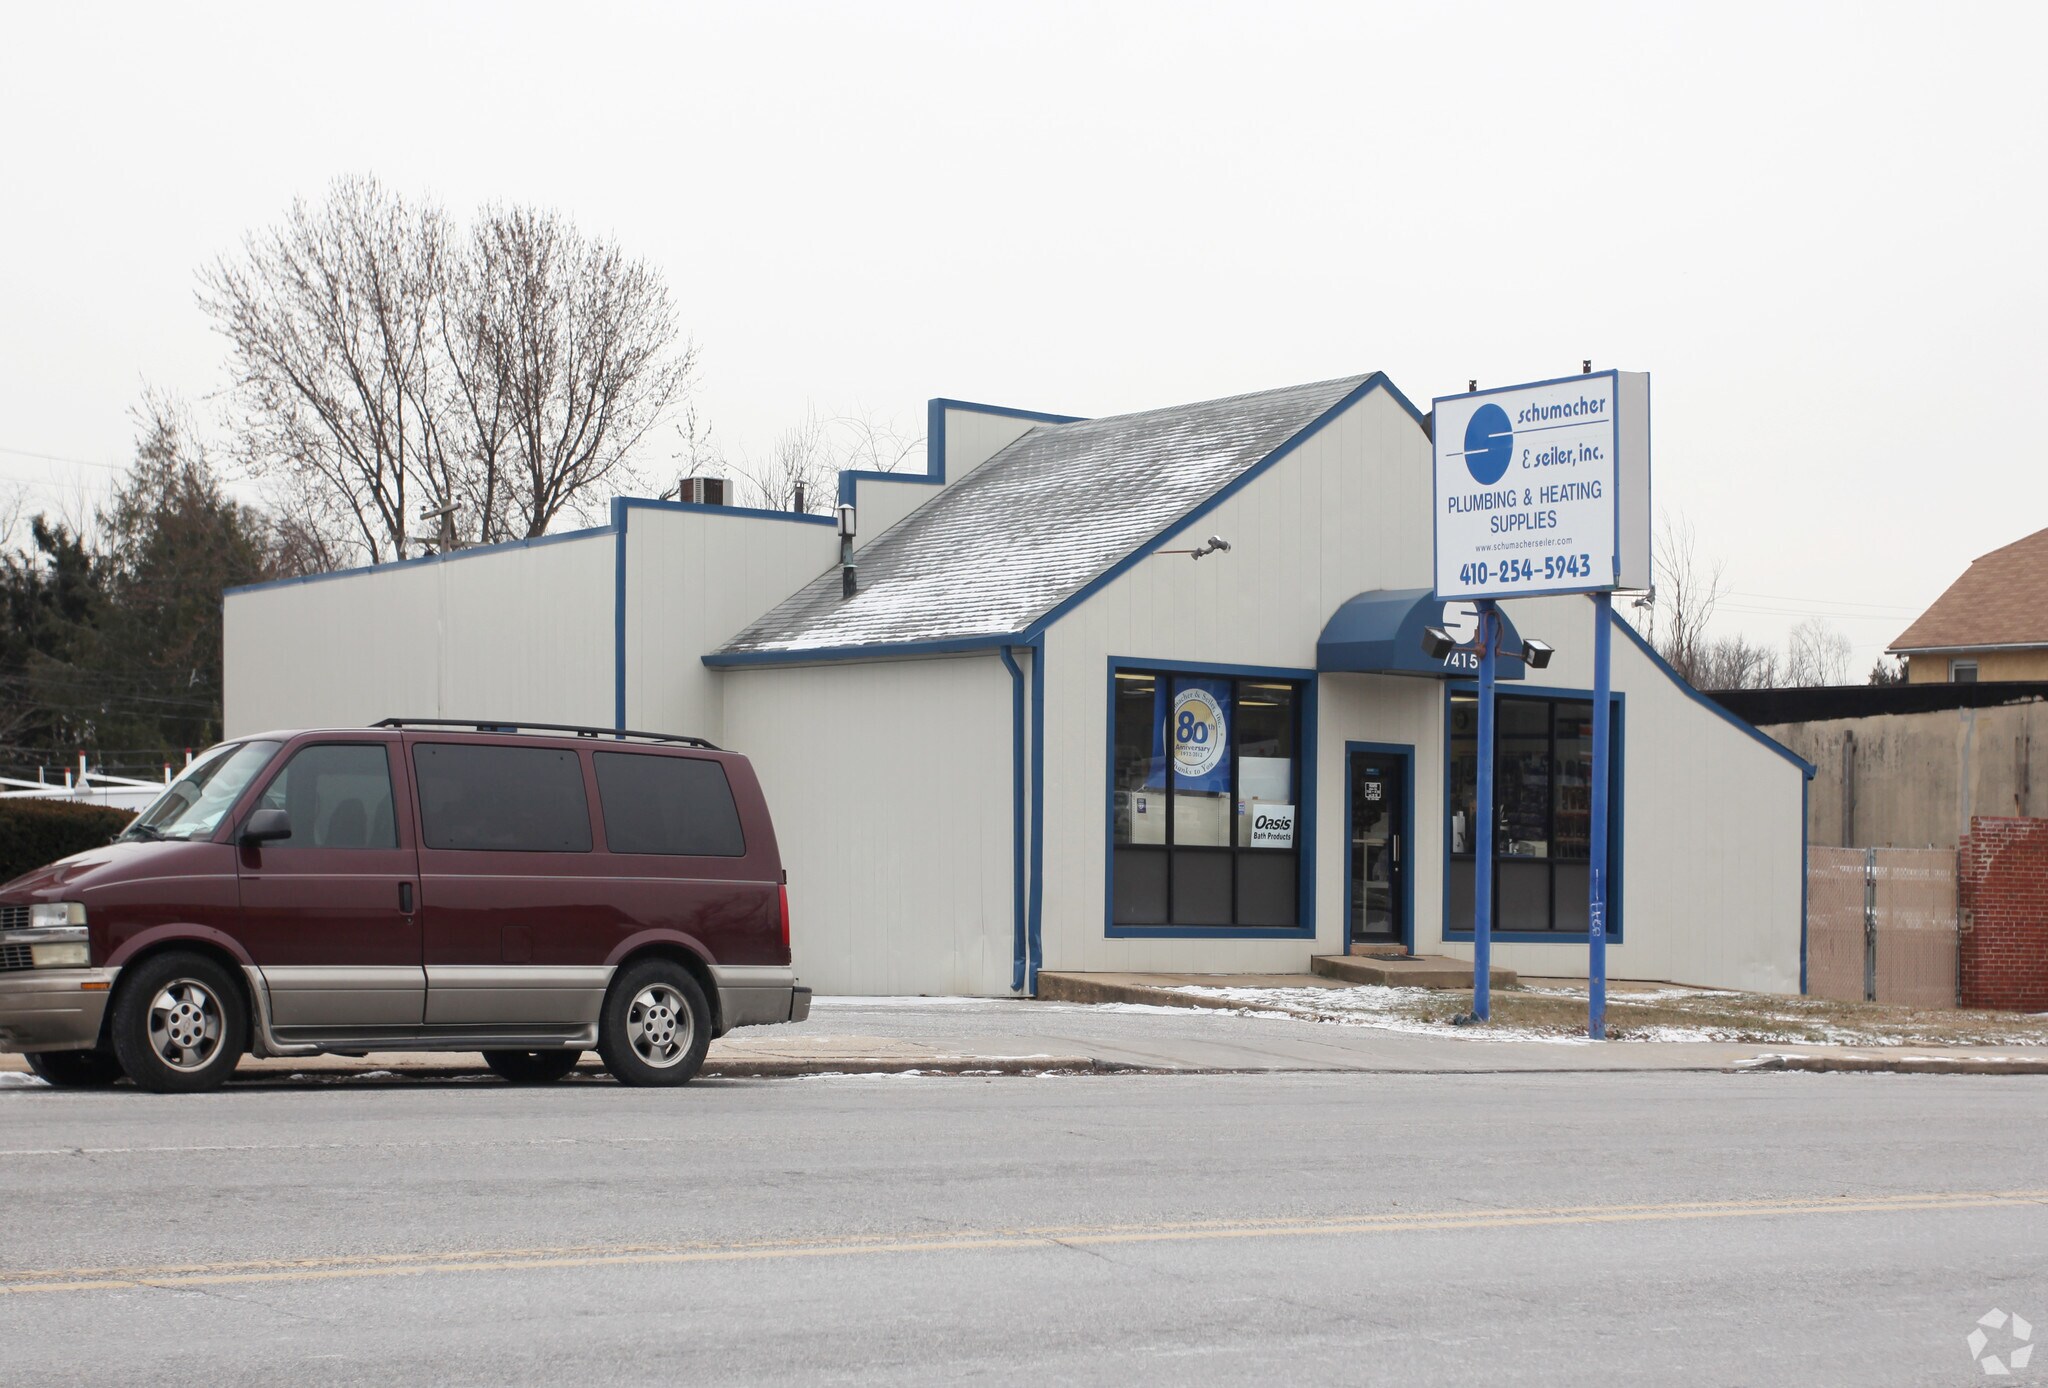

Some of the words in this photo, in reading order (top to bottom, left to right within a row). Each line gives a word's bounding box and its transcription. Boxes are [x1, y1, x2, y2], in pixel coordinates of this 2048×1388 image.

[1517, 396, 1606, 424] schumacher
[1533, 447, 1577, 469] seiler,
[1579, 443, 1604, 462] inc.
[1448, 490, 1517, 513] PLUMBING
[1523, 488, 1533, 505] &
[1540, 480, 1602, 504] HEATING
[1490, 510, 1557, 533] SUPPLIES
[1475, 537, 1573, 552] www.schumacherseiler.com
[1459, 553, 1591, 585] 410-254-5943
[1175, 744, 1211, 753] Anniversary
[1255, 815, 1291, 830] Oasis
[1253, 832, 1266, 840] Bath
[1267, 832, 1291, 840] Products
